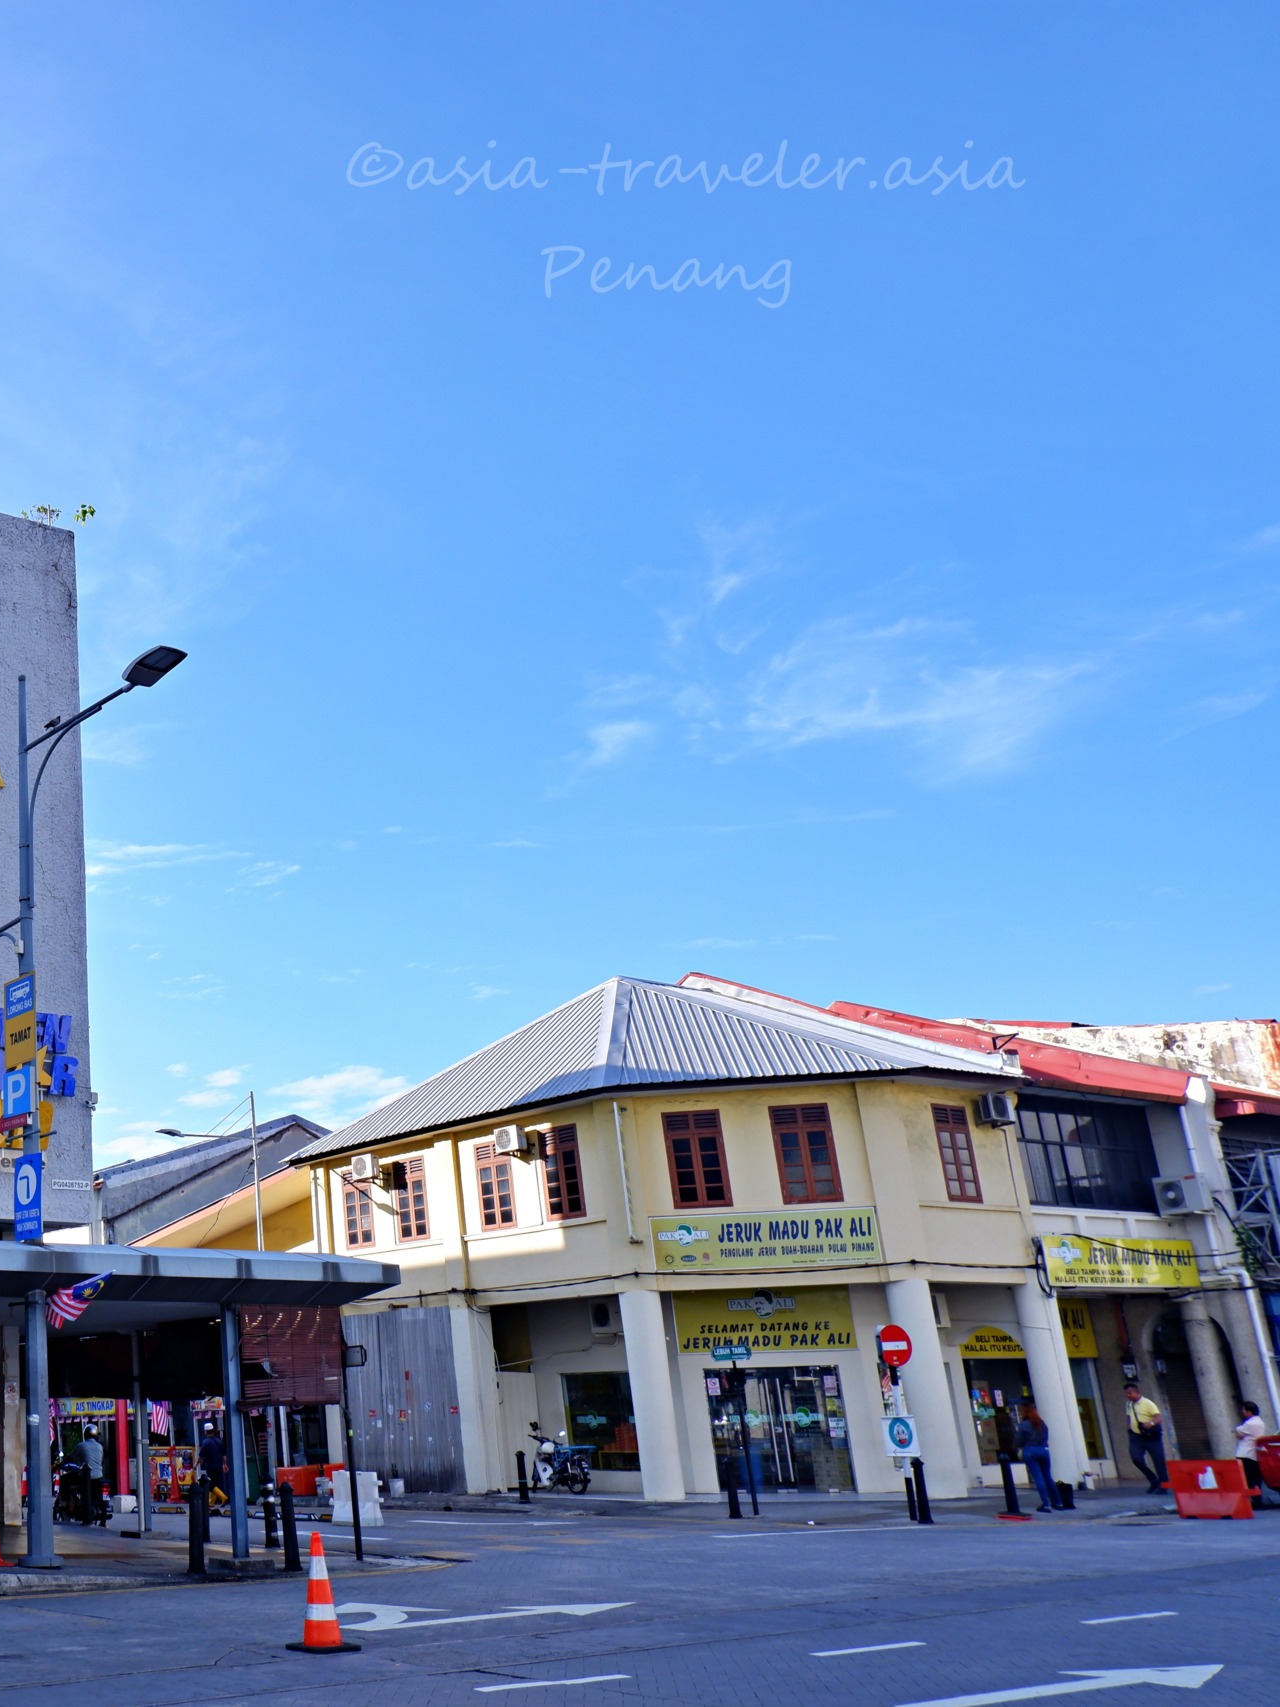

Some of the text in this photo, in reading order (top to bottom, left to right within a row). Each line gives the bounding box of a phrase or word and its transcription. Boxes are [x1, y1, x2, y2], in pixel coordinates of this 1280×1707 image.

[7, 998, 33, 1016] LORONG BAS
[9, 1026, 32, 1046] TAMAT
[7, 1073, 26, 1116] P
[659, 1232, 677, 1240] PAK
[718, 1216, 872, 1244] JERUK MADU PAK ALI
[720, 1242, 875, 1258] PENGILANG JERUK BUAH-BUAHAN PULAU PINANG
[1088, 1247, 1192, 1267] JERUK MADU PAK ALI
[1055, 1275, 1076, 1283] HALAL
[730, 1299, 794, 1309] PAK ALI
[1071, 1307, 1086, 1330] ALI
[700, 1321, 831, 1334] SELAMAT DATANG KE
[737, 1334, 782, 1348] MADU
[790, 1333, 820, 1346] PAK
[827, 1332, 851, 1345] ALI
[975, 1335, 1014, 1343] BELI TANPA
[713, 1346, 747, 1356] LEBUH TAMIL
[964, 1344, 988, 1352] HALAL
[989, 1344, 1002, 1352] ITU
[75, 1400, 115, 1412] AIS TINGKAP
